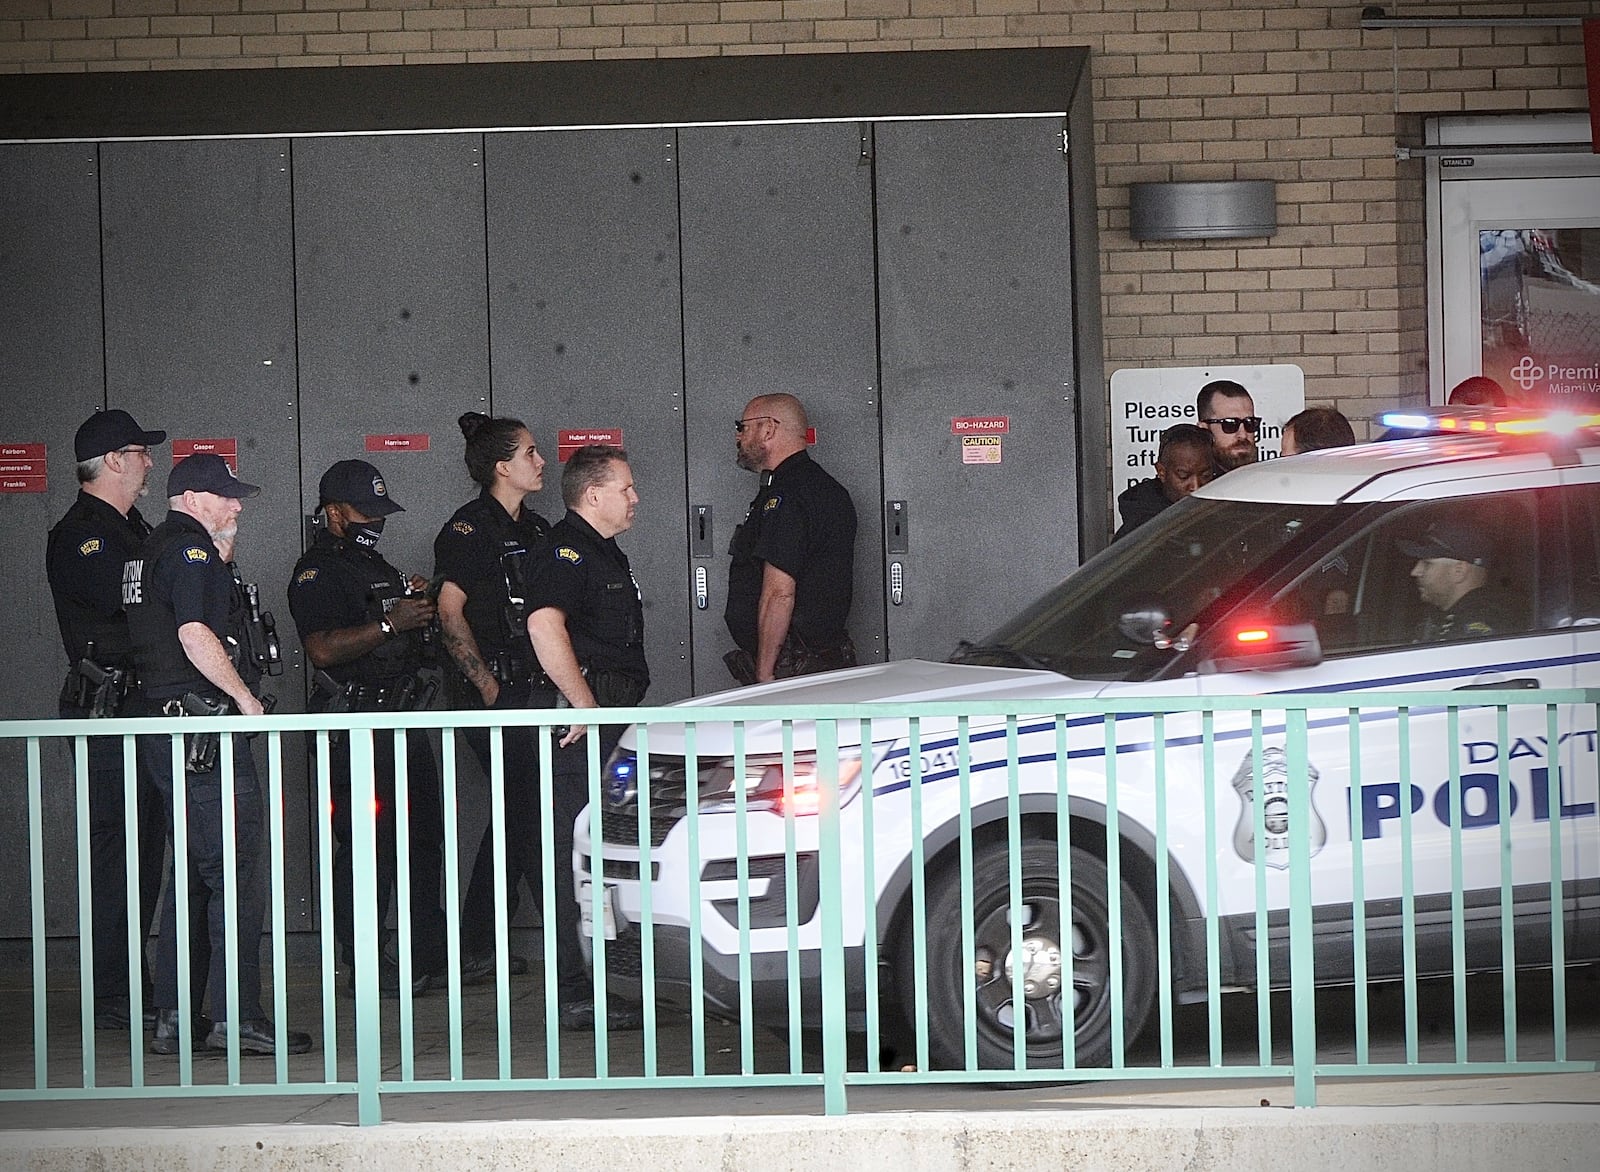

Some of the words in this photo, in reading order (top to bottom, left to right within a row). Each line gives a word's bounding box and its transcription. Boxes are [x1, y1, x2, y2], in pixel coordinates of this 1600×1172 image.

[1549, 383, 1586, 394] Miami
[1125, 401, 1196, 419] Please
[956, 421, 1004, 429] BIO-HAZARD
[964, 437, 999, 445] CAUTION
[893, 502, 901, 510] 18
